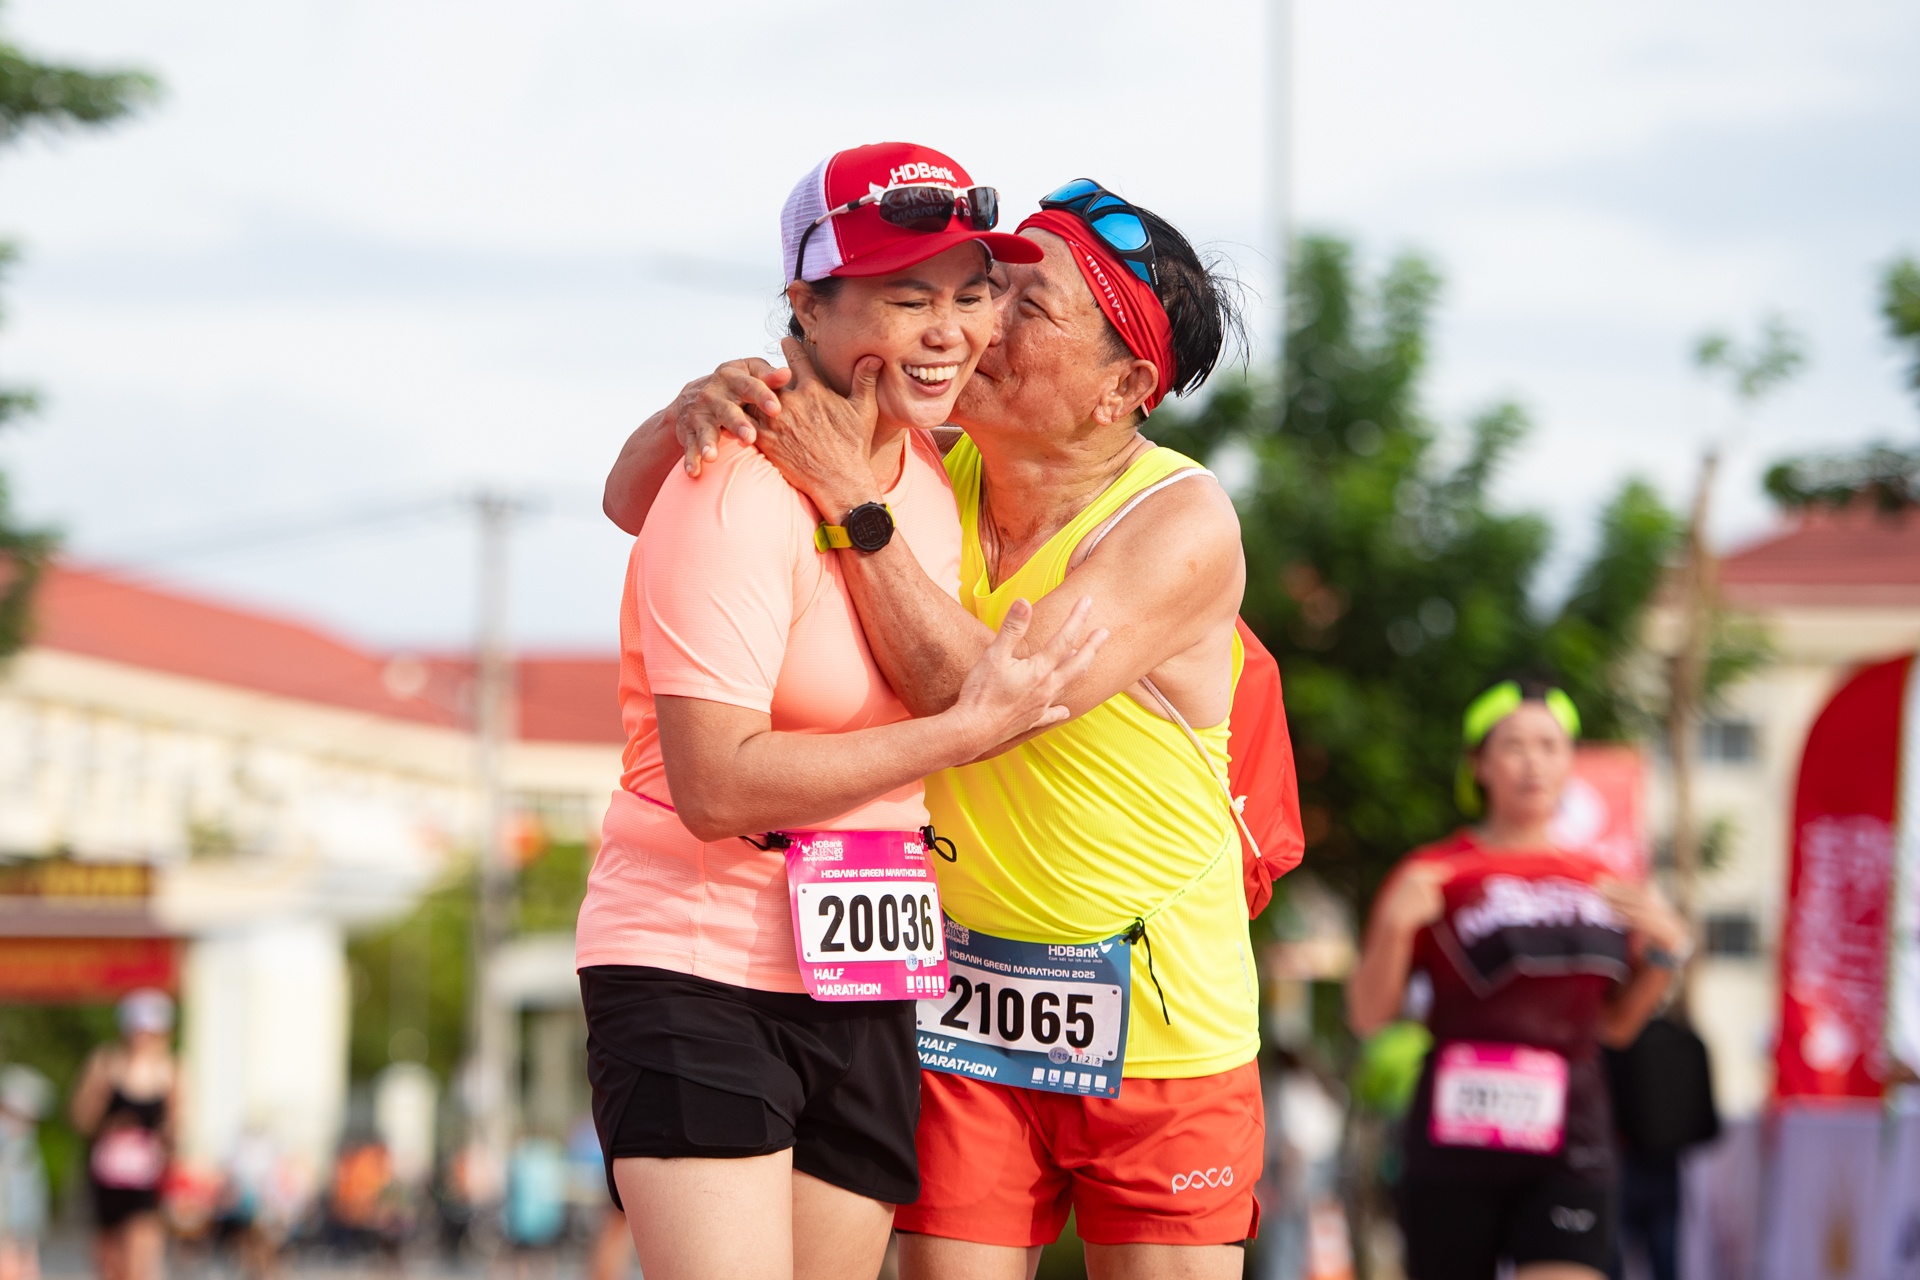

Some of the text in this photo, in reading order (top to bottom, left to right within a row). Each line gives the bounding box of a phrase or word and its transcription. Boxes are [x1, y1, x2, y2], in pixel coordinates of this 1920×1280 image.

[890, 162, 957, 183] HDBank
[812, 840, 843, 848] HDBank
[821, 869, 858, 879] HDBANK
[859, 868, 885, 878] GREEN
[885, 868, 917, 878] MARATHON
[818, 894, 934, 952] 20036
[1048, 945, 1099, 959] HDBank
[949, 948, 1096, 979] HDBANK GREEN MARATHON 2025
[813, 968, 845, 980] HALF
[817, 983, 882, 996] MARATHON
[940, 975, 1095, 1049] 21065
[917, 1036, 957, 1053] HALF
[917, 1051, 998, 1078] MARATHON
